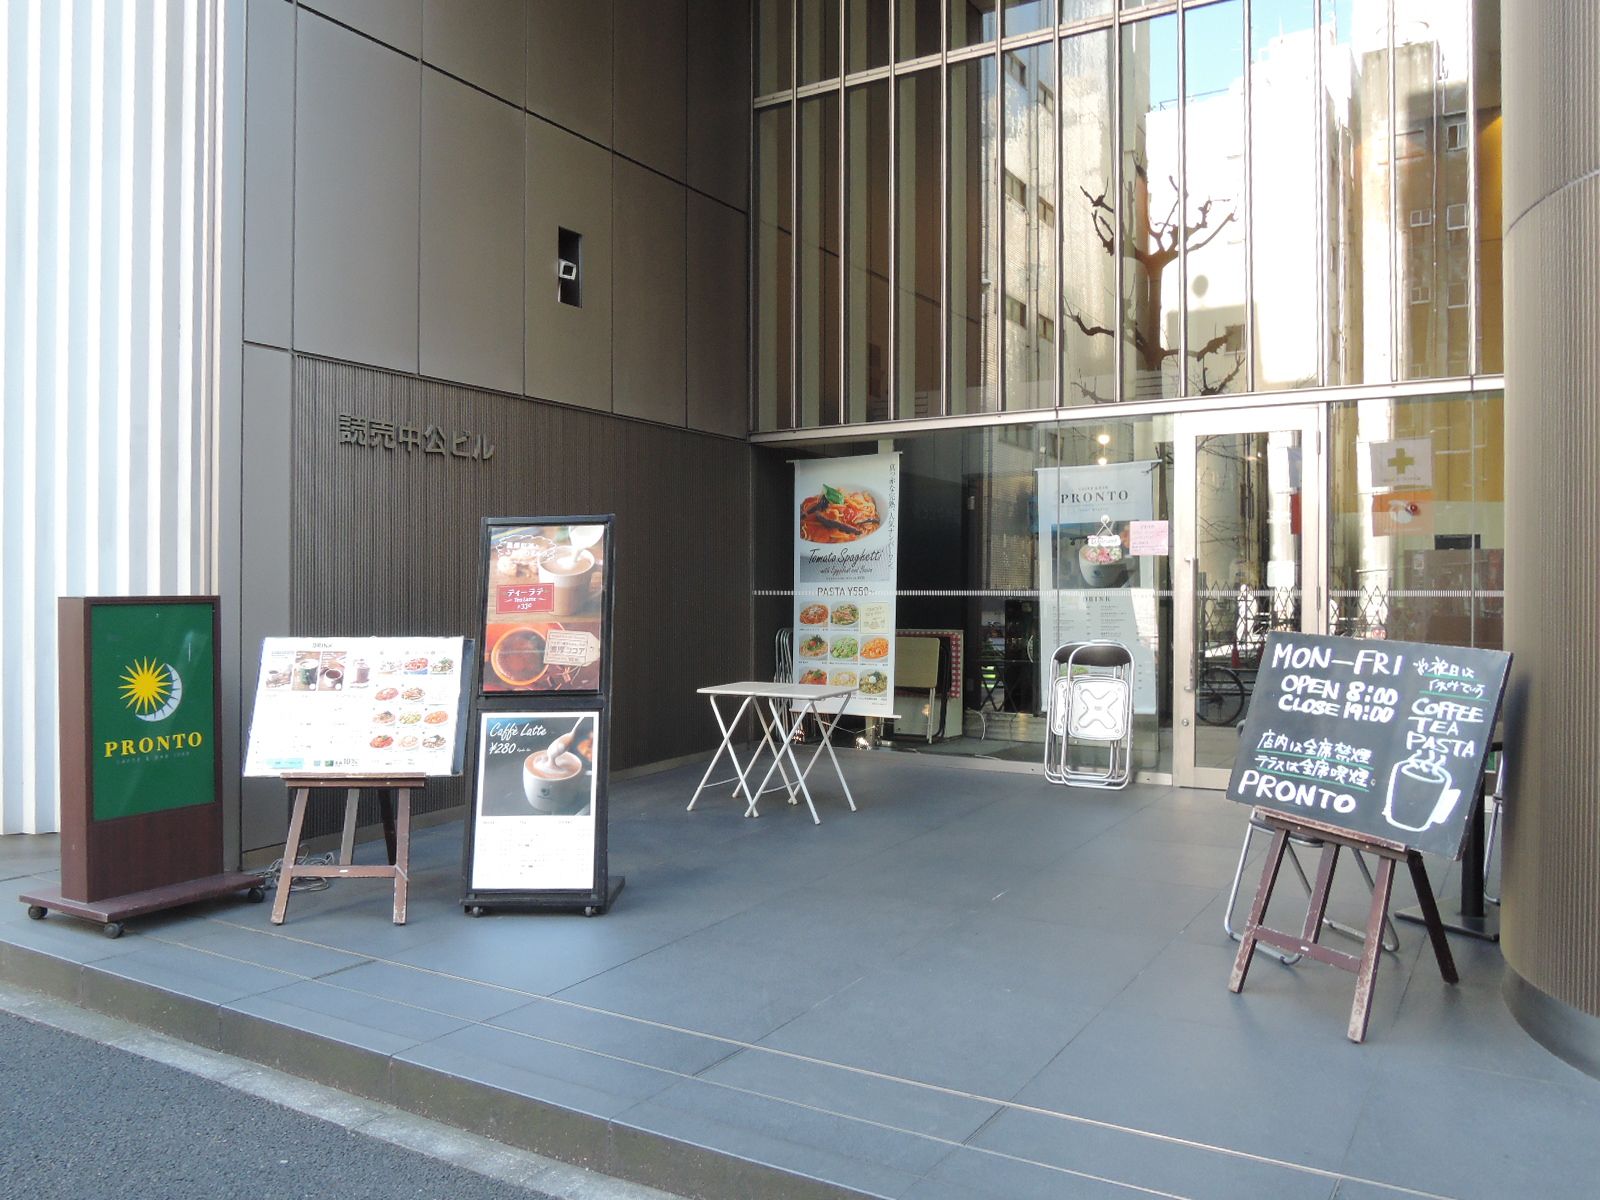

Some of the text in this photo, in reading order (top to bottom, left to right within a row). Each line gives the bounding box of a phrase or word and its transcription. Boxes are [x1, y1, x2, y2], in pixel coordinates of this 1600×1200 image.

[1060, 489, 1129, 504] PRONTO
[808, 547, 884, 568] Tomato Spaghetti
[817, 586, 846, 597] PASTA
[1280, 674, 1399, 706] OPEN 8:00
[1278, 693, 1396, 724] CLOSE 19:00
[520, 722, 548, 737] Latte
[1407, 716, 1459, 736] TEA
[103, 731, 204, 758] PRONTO
[489, 742, 517, 755] ¥280
[1256, 729, 1373, 765] 店内は全席禁煙
[1406, 730, 1476, 758] PASTA
[1237, 769, 1356, 814] PRONTO
